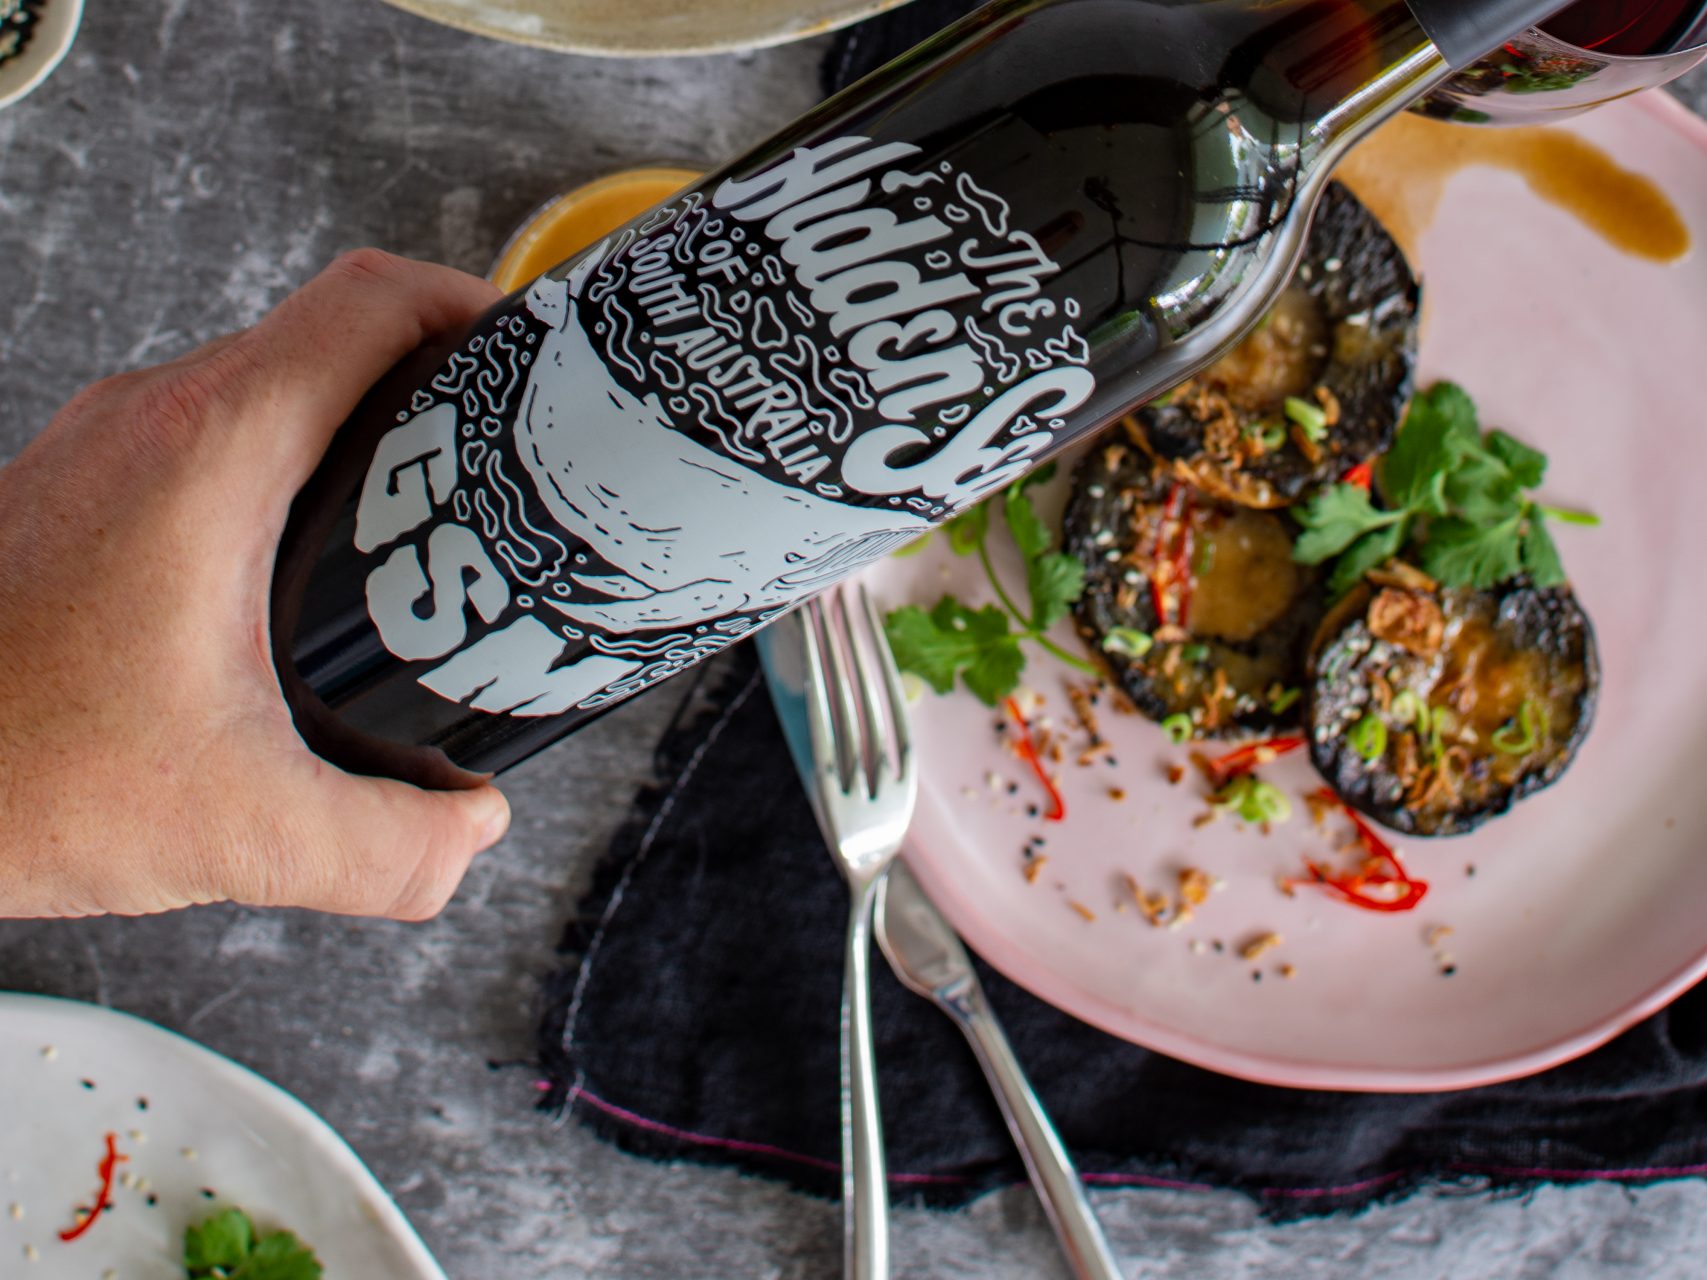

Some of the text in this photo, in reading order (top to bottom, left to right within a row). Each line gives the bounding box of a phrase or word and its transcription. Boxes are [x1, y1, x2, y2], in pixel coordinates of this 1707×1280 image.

[630, 233, 833, 484] SOUTH AUSTRALIA
[699, 240, 749, 284] OF
[712, 136, 985, 420] Hidden
[354, 403, 643, 717] GSM
